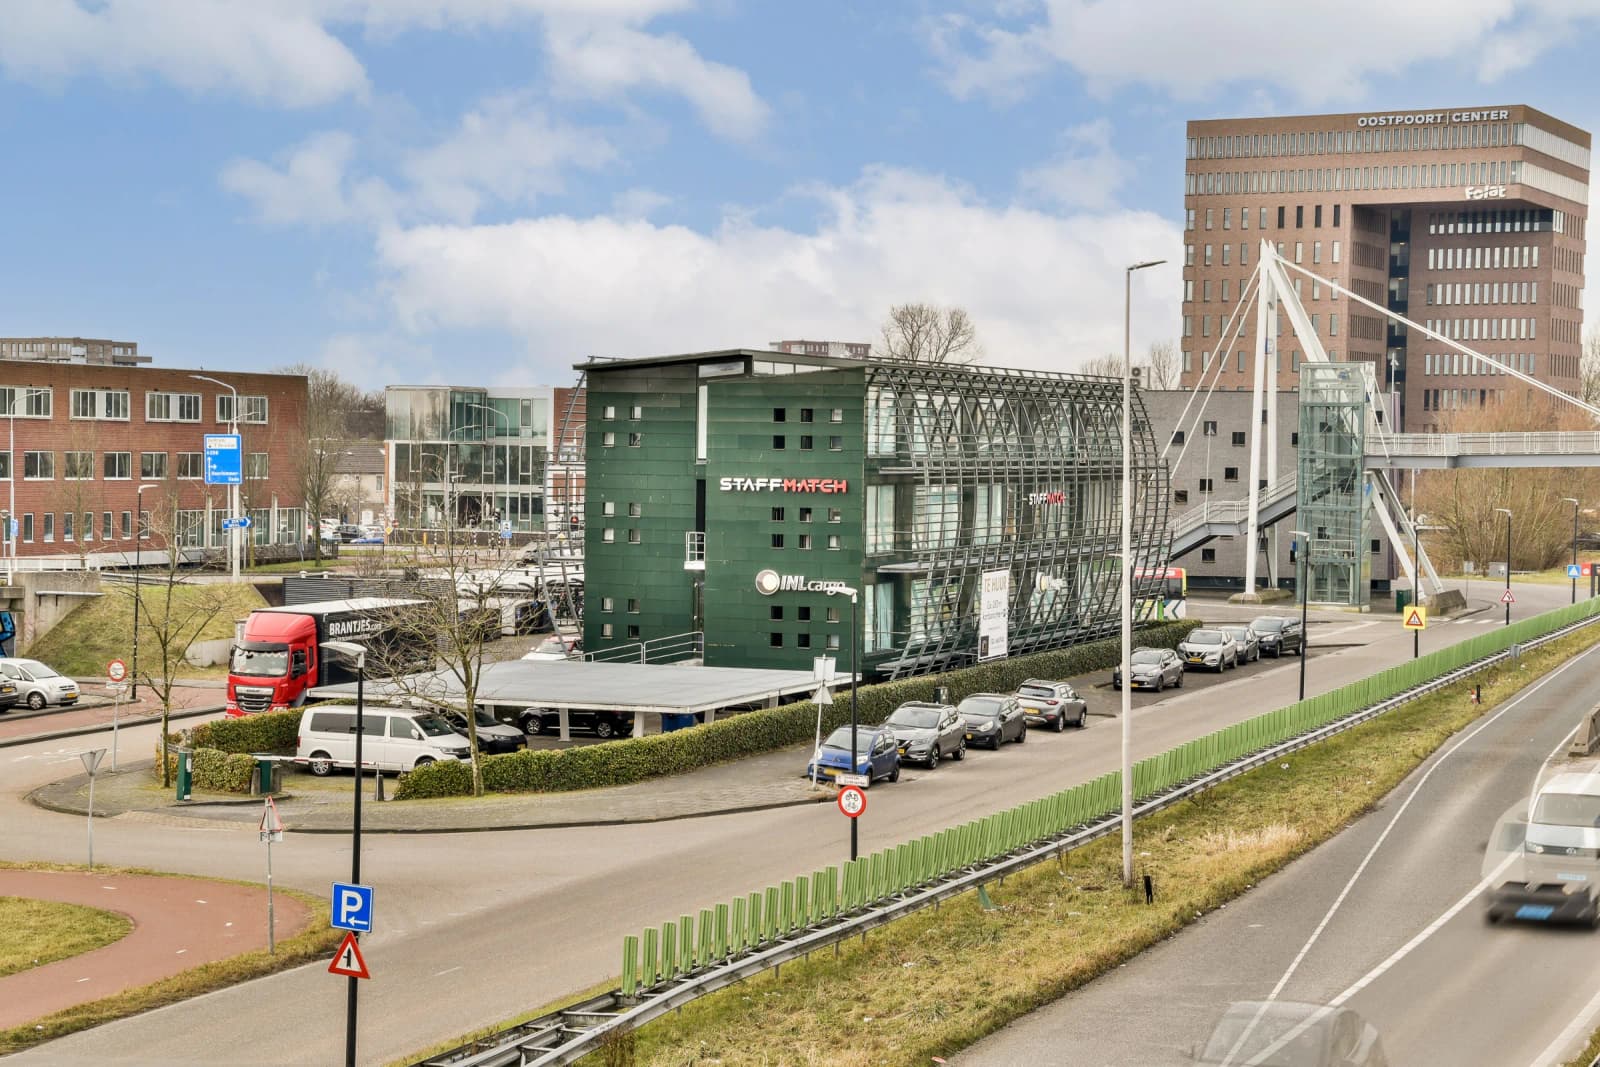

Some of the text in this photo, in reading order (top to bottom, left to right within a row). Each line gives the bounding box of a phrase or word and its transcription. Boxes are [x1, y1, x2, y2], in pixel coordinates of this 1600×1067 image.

[1357, 110, 1509, 127] OOSTPOORT CENTER
[719, 477, 849, 493] STAFFMATCH
[340, 889, 363, 923] P
